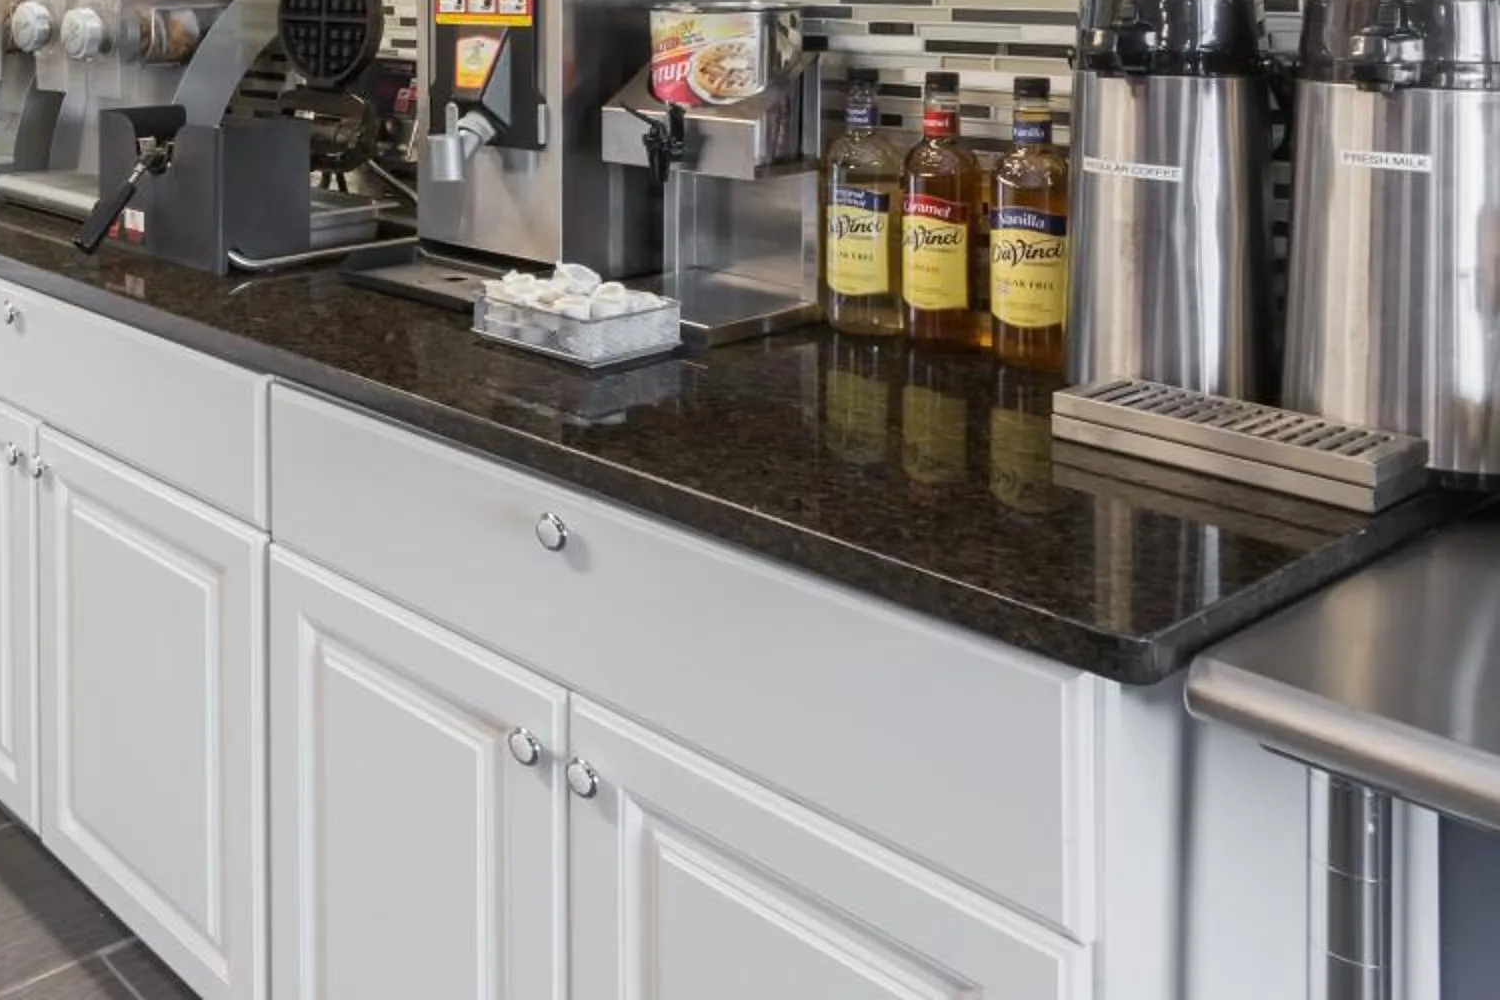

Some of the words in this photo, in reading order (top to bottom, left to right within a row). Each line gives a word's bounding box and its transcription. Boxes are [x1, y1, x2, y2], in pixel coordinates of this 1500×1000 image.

[1392, 154, 1428, 168] MILK
[831, 214, 884, 239] aVinci
[996, 212, 1046, 230] Vanilla
